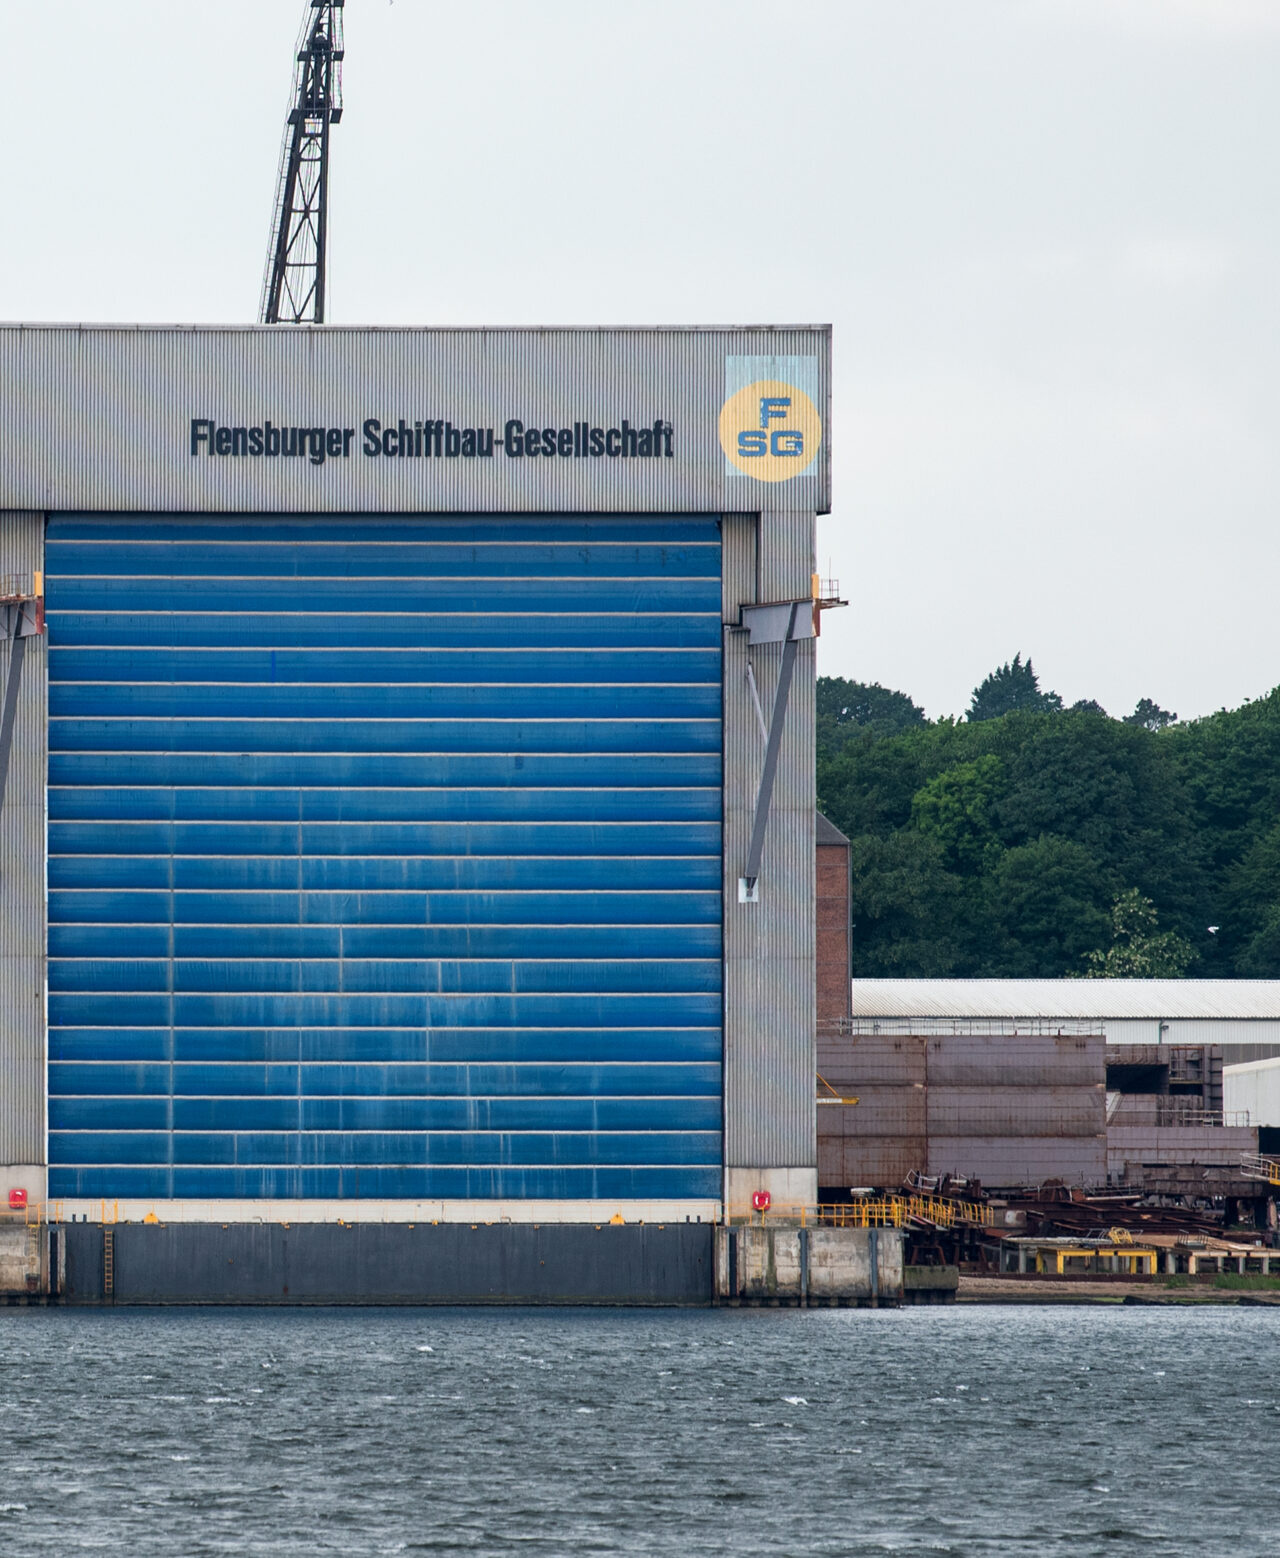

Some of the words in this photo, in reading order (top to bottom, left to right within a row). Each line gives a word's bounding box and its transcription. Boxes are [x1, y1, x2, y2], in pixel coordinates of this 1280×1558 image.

[760, 398, 792, 428] F
[191, 418, 354, 466] Flensburger
[363, 418, 674, 458] Schiffbau-Gesellschaft
[738, 430, 804, 457] SG
